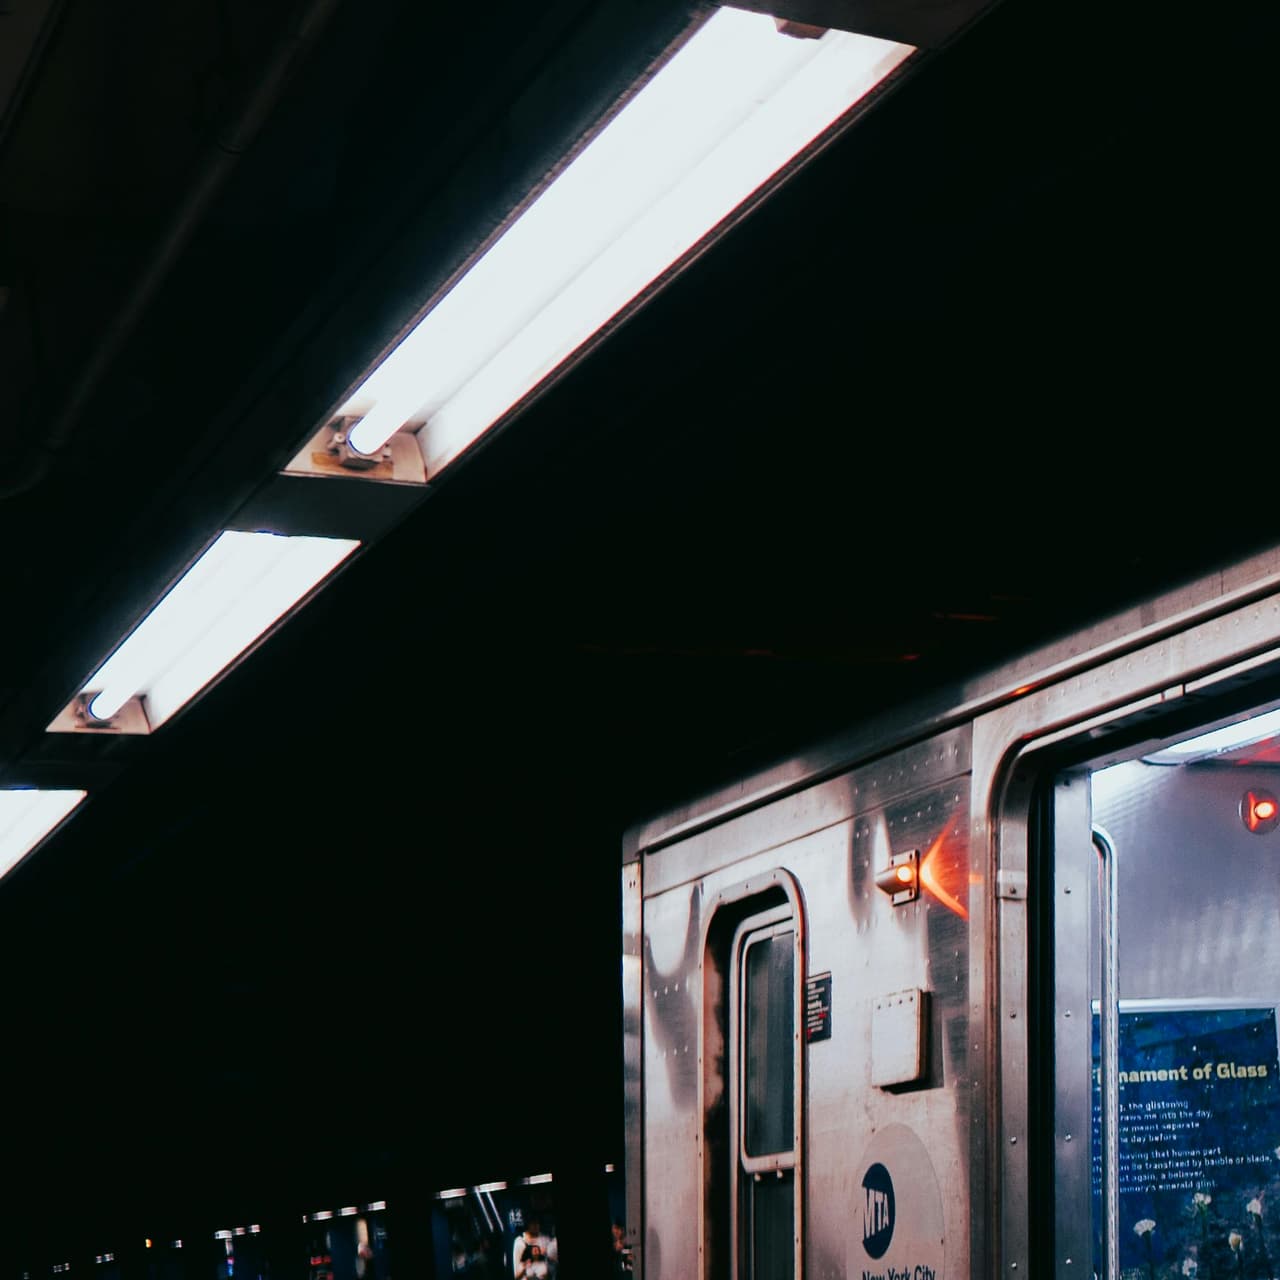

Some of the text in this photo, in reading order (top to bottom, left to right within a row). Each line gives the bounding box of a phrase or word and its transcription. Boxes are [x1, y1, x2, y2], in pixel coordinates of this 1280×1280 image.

[1193, 1063, 1213, 1079] of
[1217, 1061, 1268, 1080] Glass
[862, 1186, 890, 1240] MTA
